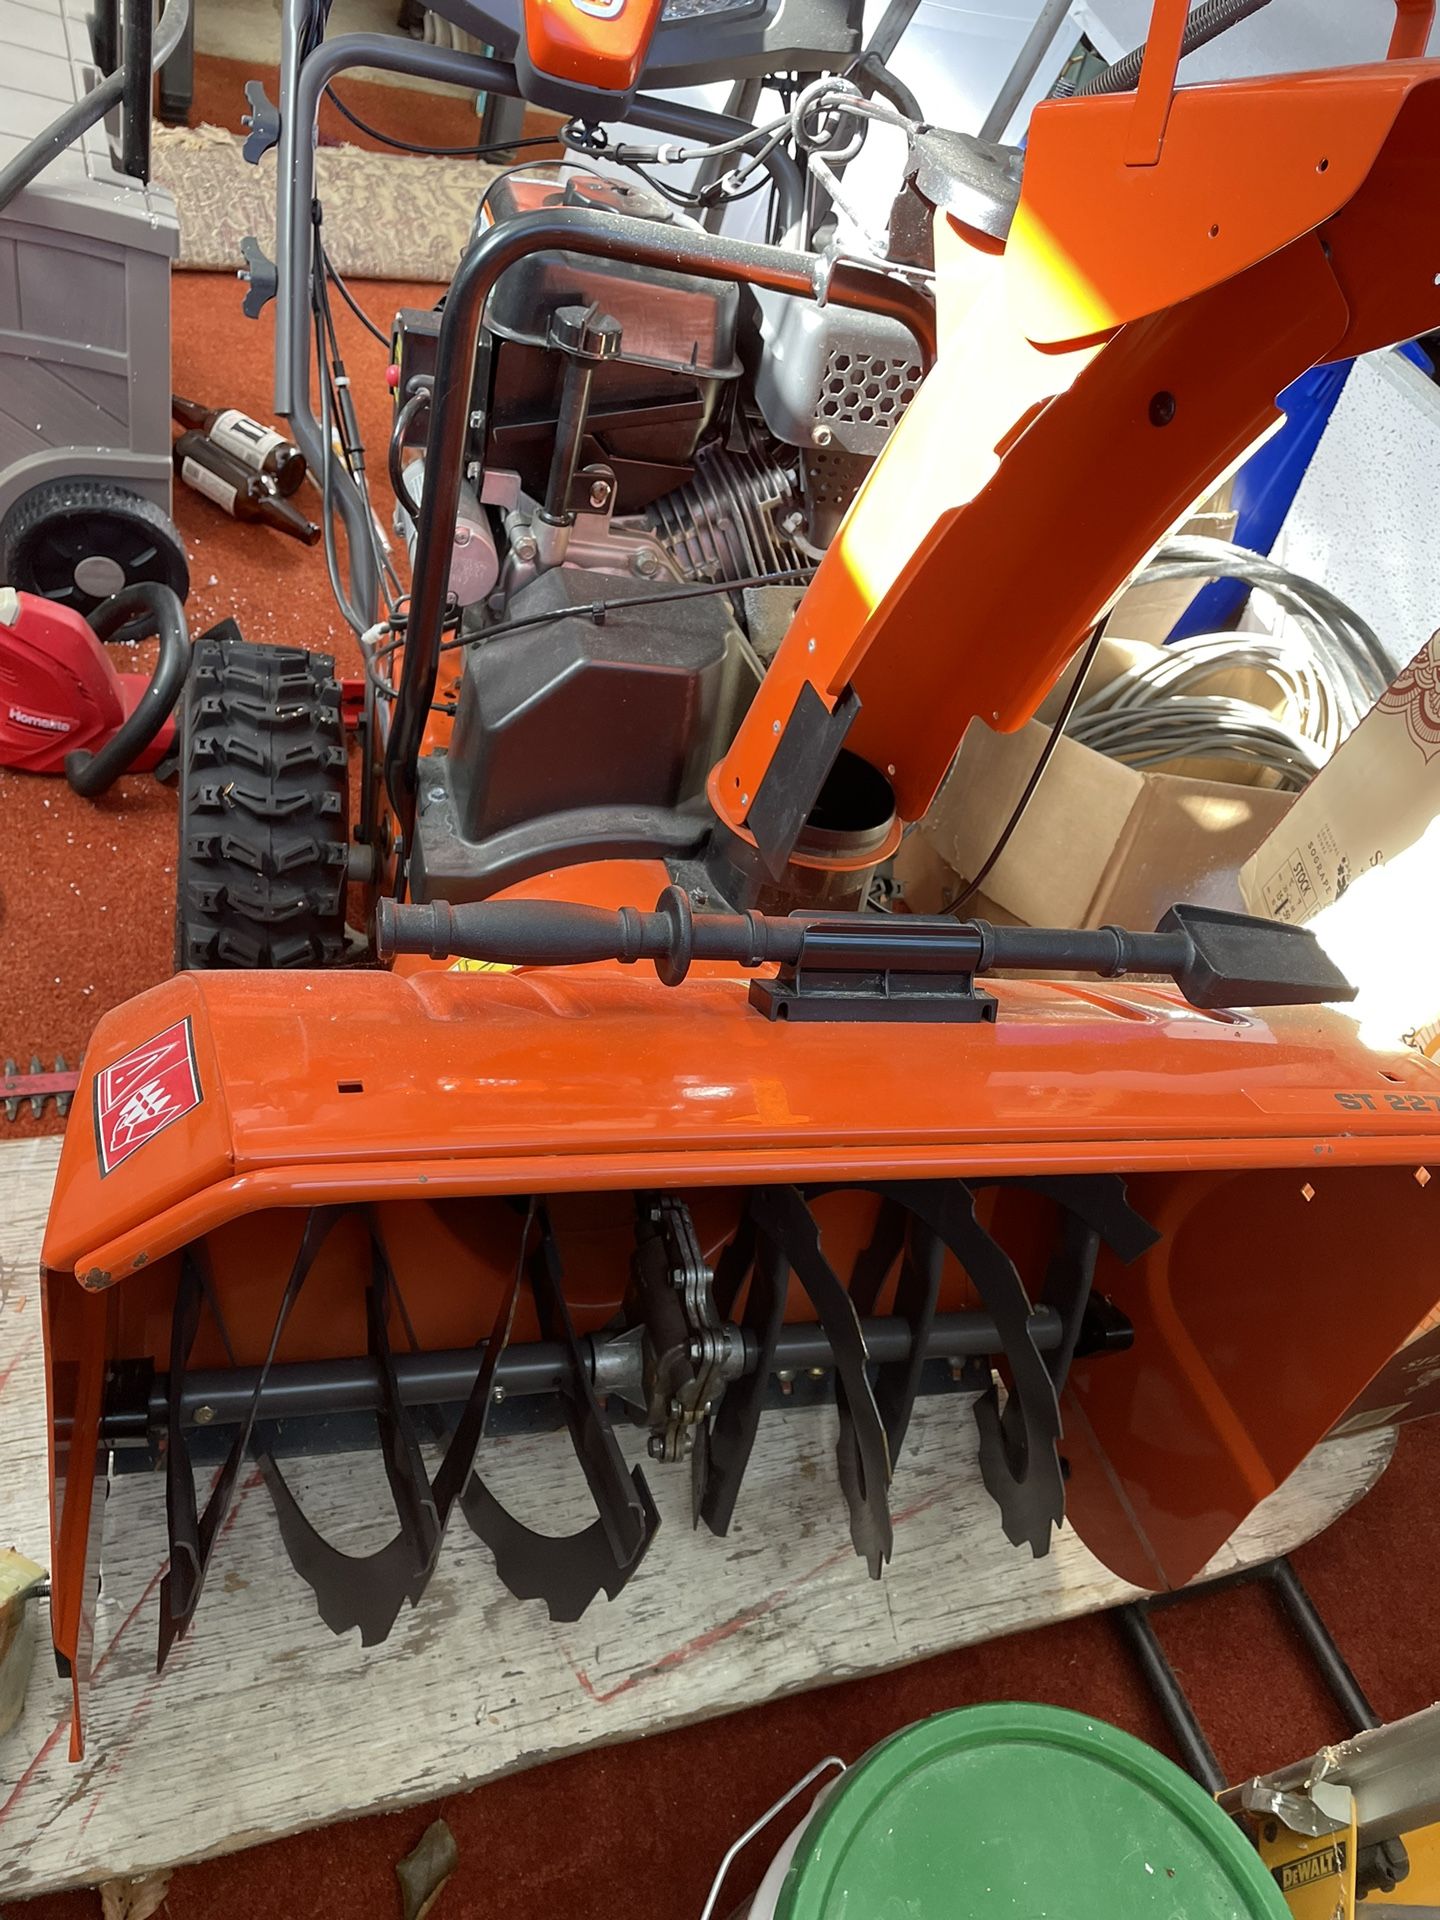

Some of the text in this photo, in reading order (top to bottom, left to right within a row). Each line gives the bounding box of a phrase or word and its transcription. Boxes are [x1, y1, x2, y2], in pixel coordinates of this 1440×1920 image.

[1293, 862, 1311, 897] STOCK
[1307, 841, 1332, 895] SOGRAPE
[1334, 1093, 1377, 1111] ST
